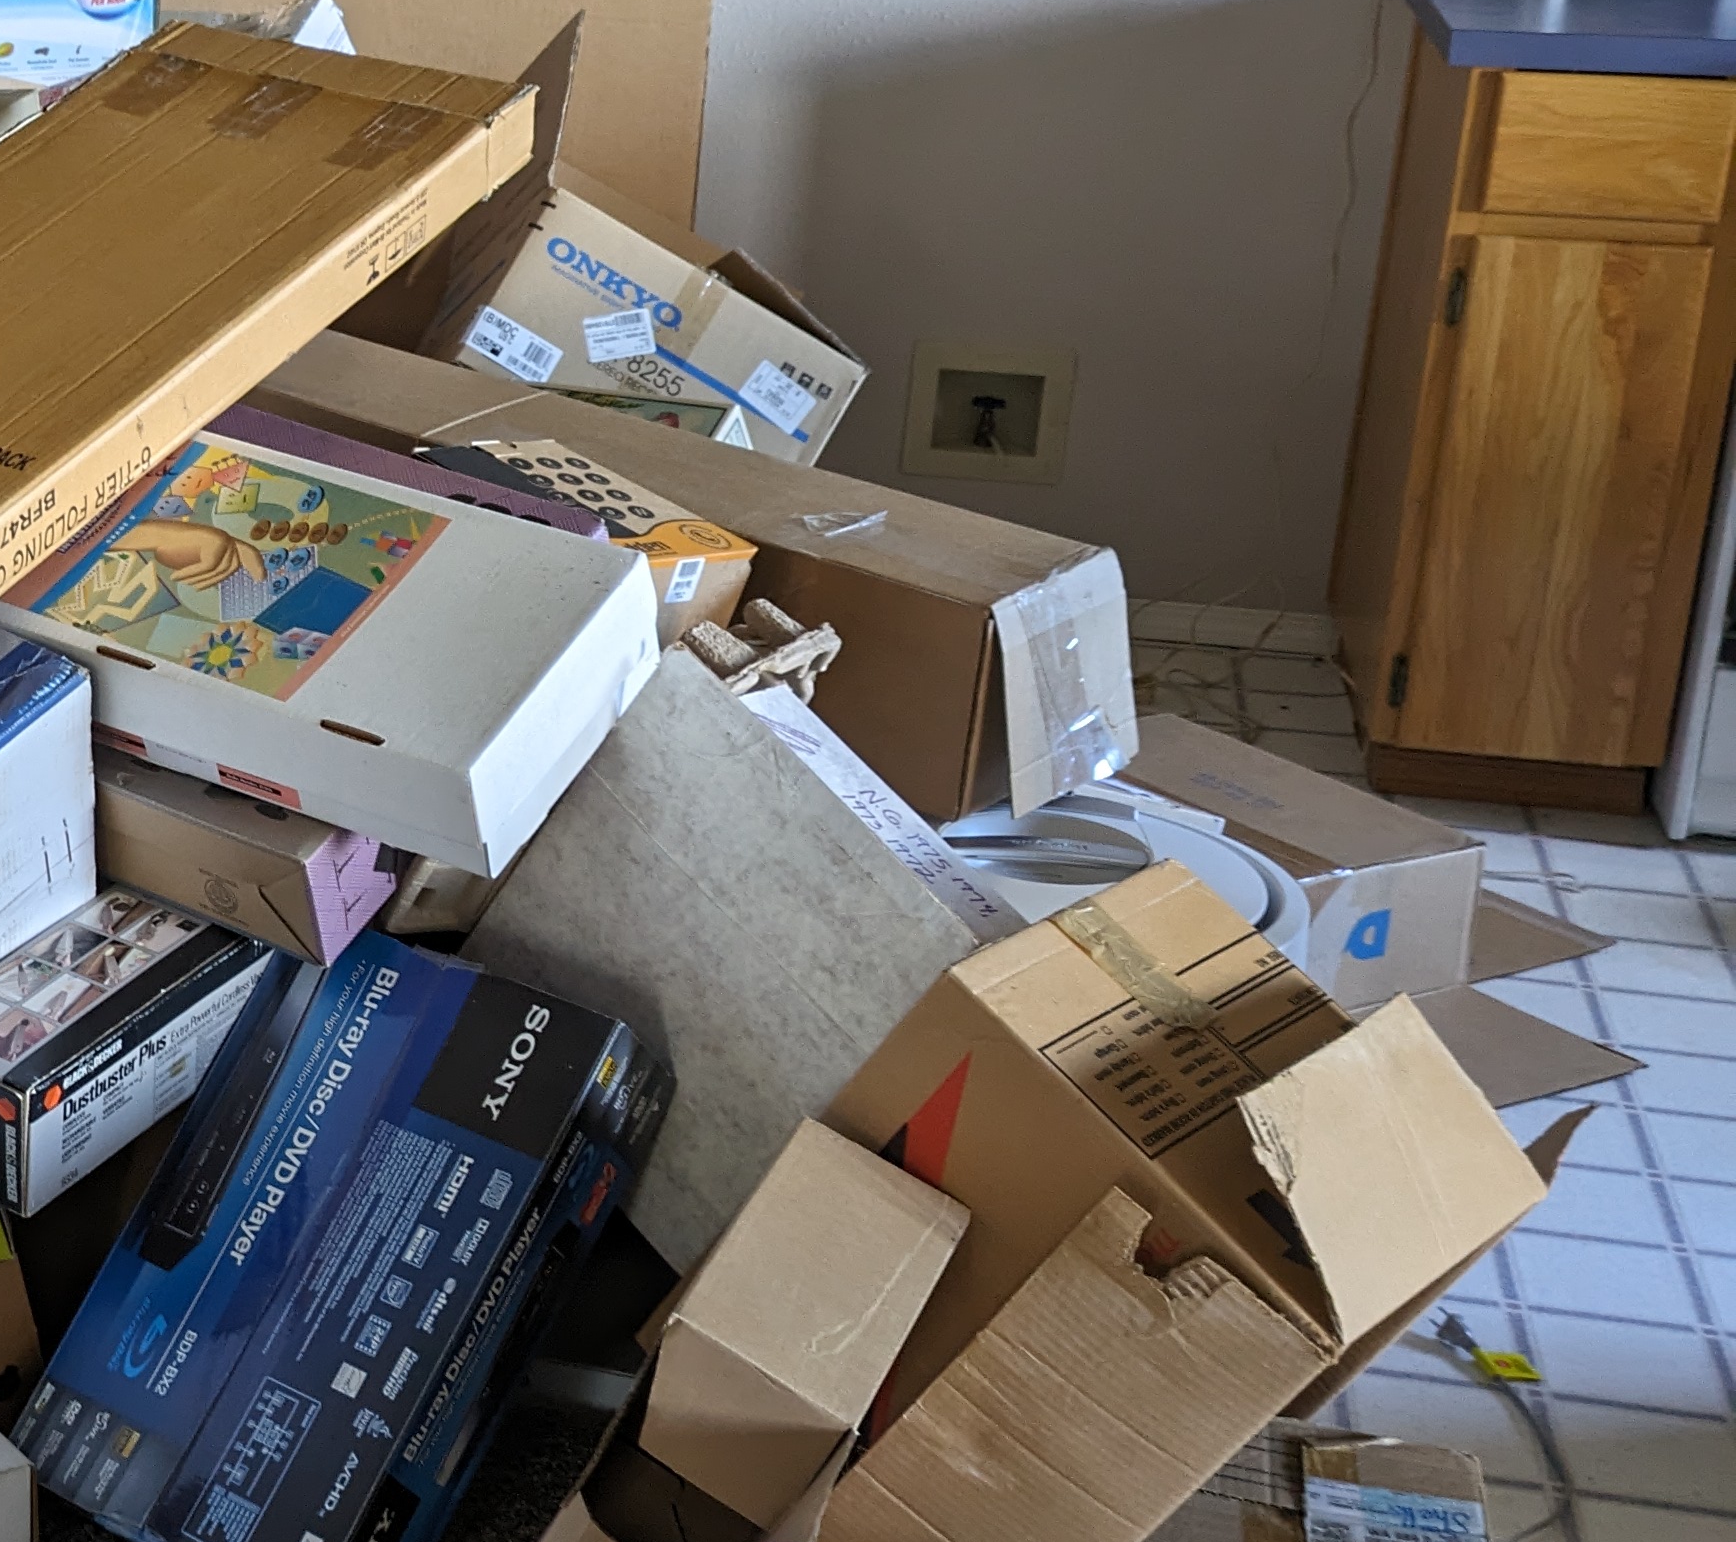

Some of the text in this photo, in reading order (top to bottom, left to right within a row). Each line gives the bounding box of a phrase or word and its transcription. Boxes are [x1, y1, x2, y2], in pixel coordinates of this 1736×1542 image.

[546, 236, 683, 330] ONKYO
[94, 445, 152, 511] 6-TIER
[12, 495, 89, 577] FOLDING
[338, 965, 401, 1059] Blu-ray
[63, 1059, 137, 1121] Dustbuster
[139, 1035, 168, 1068] Plus
[242, 964, 364, 1187] For your high definition movie experience
[481, 1003, 552, 1122] SONY
[229, 1186, 286, 1268] Player
[154, 1329, 199, 1397] BDP-BX2
[402, 1382, 449, 1463] Blu-ray
[504, 1206, 542, 1278] Player
[324, 1452, 359, 1512] AVCHD
